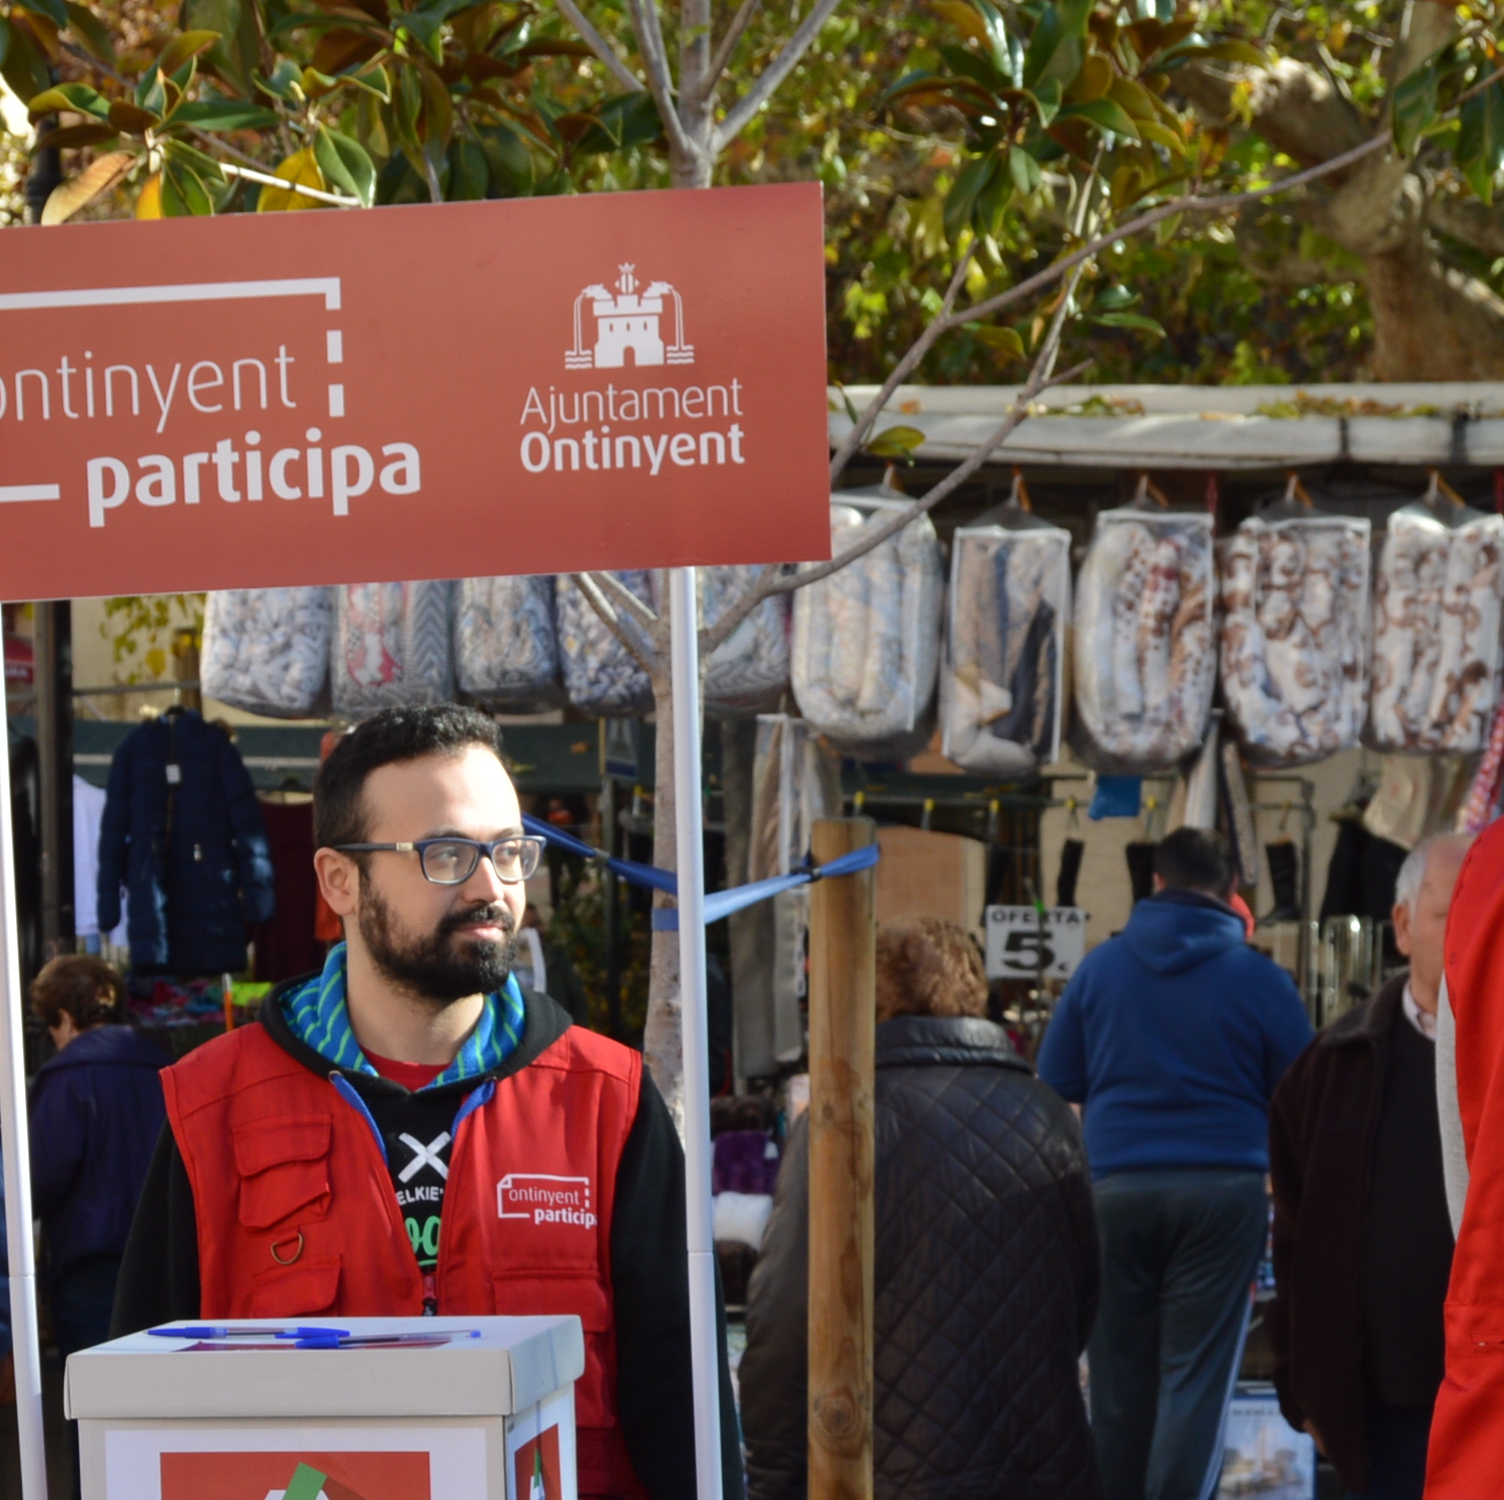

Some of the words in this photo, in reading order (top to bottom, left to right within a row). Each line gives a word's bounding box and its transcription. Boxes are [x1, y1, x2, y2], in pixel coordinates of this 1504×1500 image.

[520, 377, 744, 435] Ajuntament
[520, 422, 745, 476] Ontinyent
[86, 427, 421, 528] participa
[508, 1186, 580, 1207] ontinyent
[534, 1207, 597, 1230] particip
